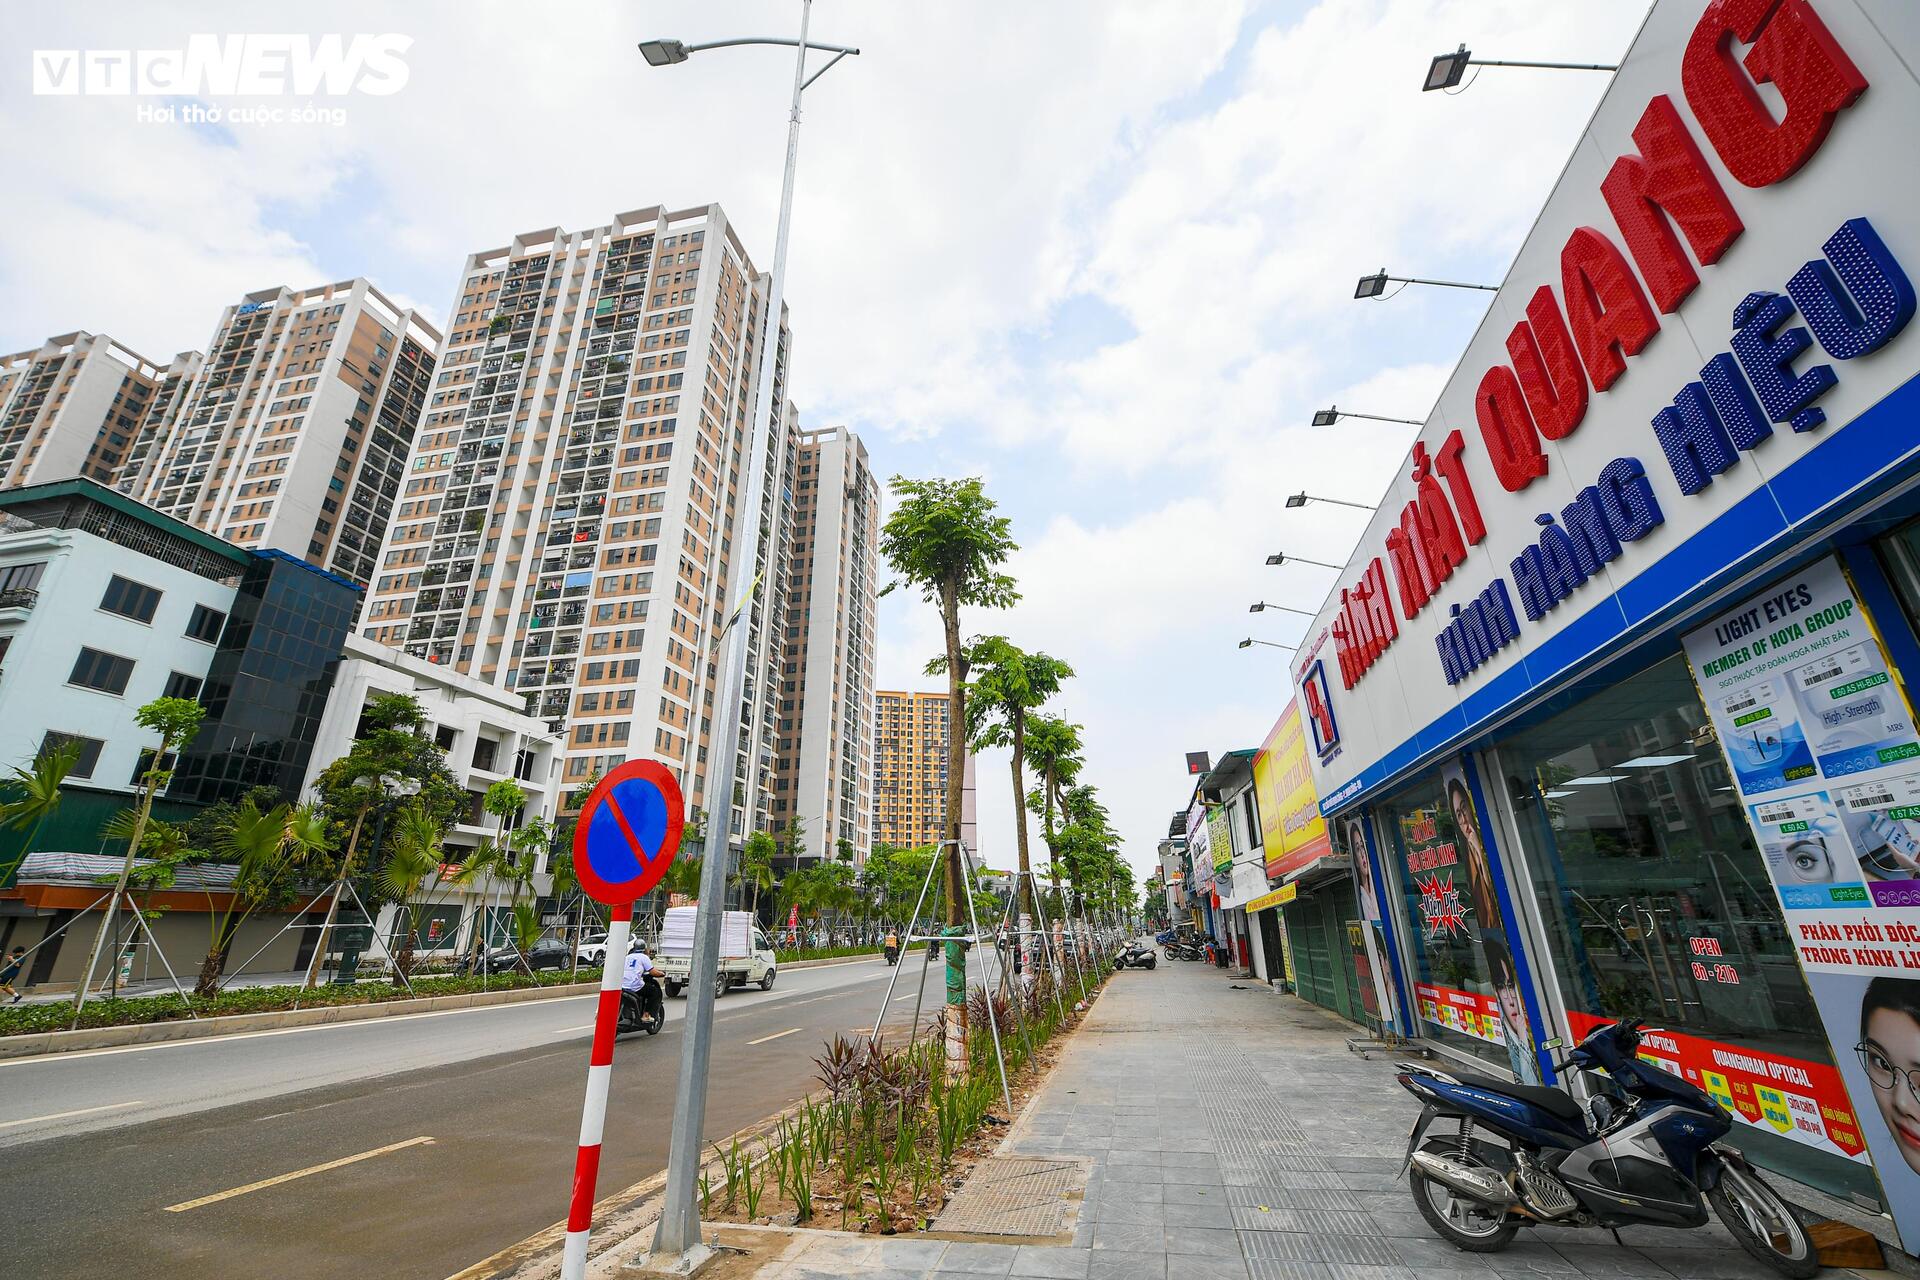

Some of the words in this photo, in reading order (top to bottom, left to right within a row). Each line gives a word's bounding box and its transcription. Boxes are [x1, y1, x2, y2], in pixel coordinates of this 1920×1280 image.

[1331, 557, 1399, 690] KÍNH
[1385, 430, 1487, 620] MẮT
[1475, 0, 1870, 493] QUANG
[1435, 578, 1521, 686] KÍNH
[1510, 456, 1665, 621] HÀNG
[1651, 217, 1917, 497] HIỆU
[1714, 608, 1762, 647] LIGHT
[1763, 583, 1813, 624] EYES
[1702, 648, 1752, 679] MEMBER
[1752, 638, 1768, 657] OF
[1769, 622, 1805, 650] HOYA
[1804, 599, 1854, 634] GROUP
[1857, 674, 1886, 691] HI-BLUE
[1822, 710, 1841, 727] High
[1845, 698, 1880, 719] Strength
[1880, 746, 1918, 762] Light-Eyes
[1831, 888, 1865, 900] Light-Eyes
[1799, 920, 1842, 941] PHÂN
[1843, 916, 1884, 942] PHỐI
[1884, 920, 1920, 948] ĐỘC
[1690, 937, 1722, 957] OPEN
[1800, 943, 1852, 965] TRÒNG
[1852, 944, 1898, 967] KÍNH
[1691, 962, 1709, 981] 8h
[1714, 964, 1740, 984] 21h
[1650, 1034, 1680, 1054] OPTICAL
[1712, 1048, 1769, 1077] QUANGNHAN
[1768, 1061, 1814, 1088] OPTICAL
